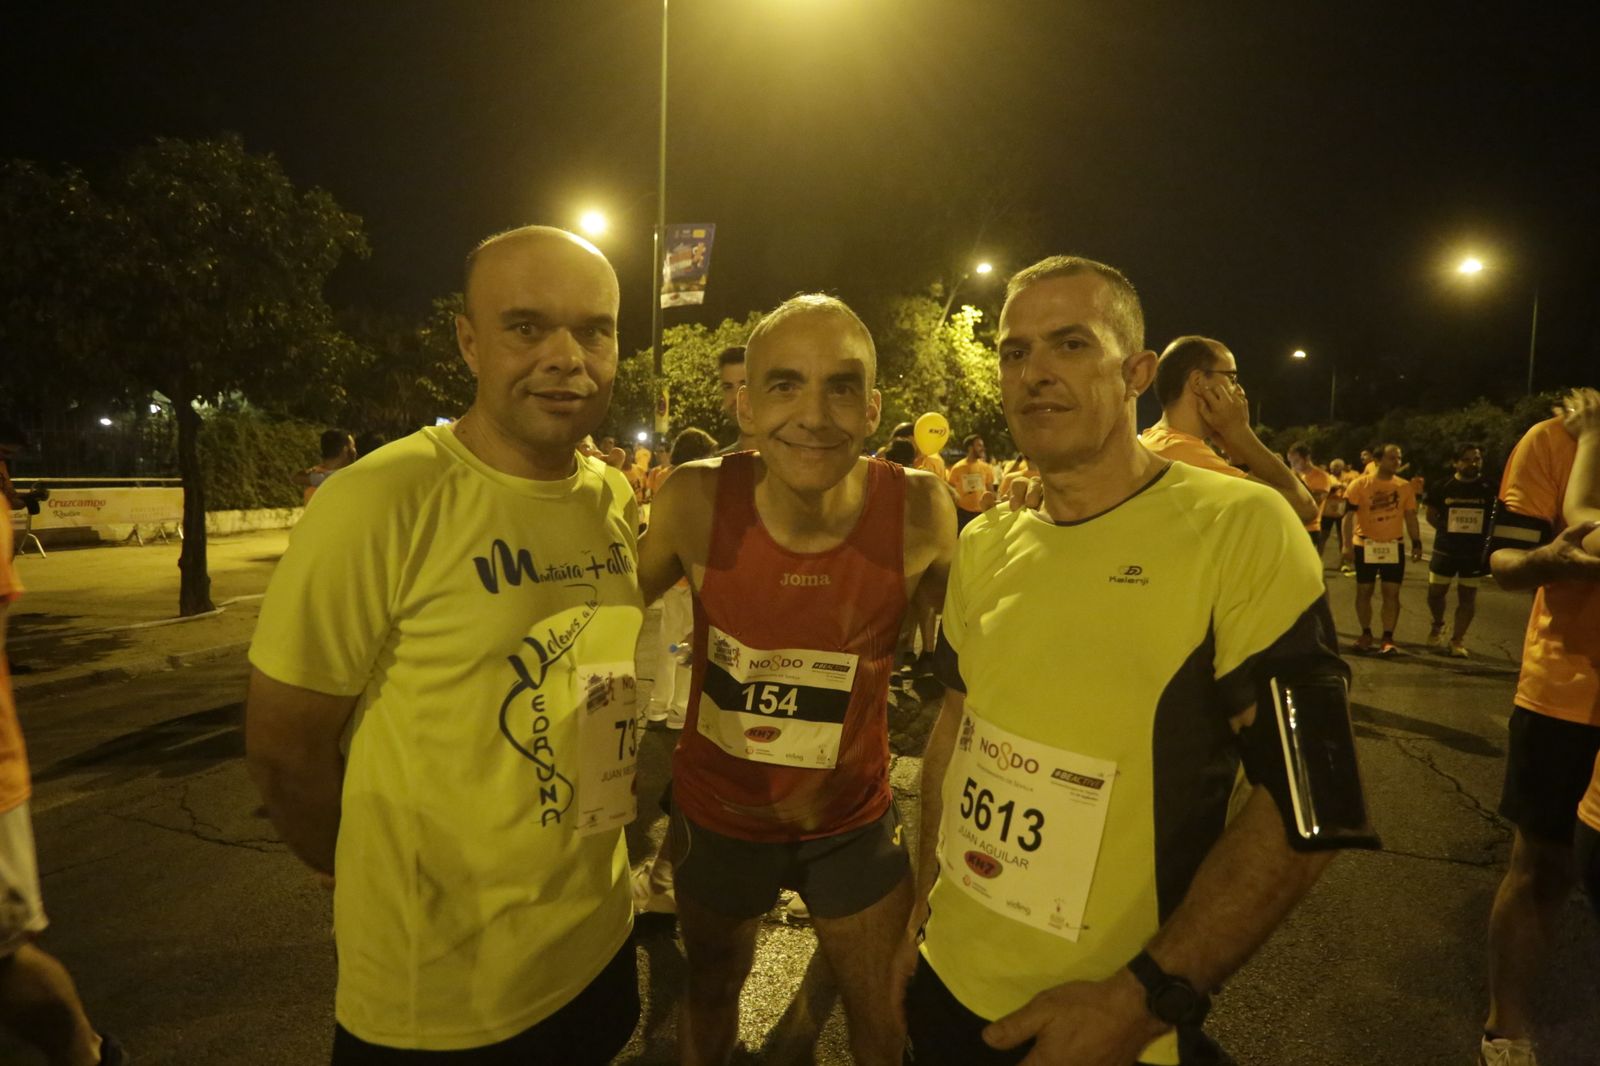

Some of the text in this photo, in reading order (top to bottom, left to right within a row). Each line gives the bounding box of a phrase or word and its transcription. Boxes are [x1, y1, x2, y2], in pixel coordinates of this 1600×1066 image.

[48, 499, 106, 510] Cruzcampo
[741, 683, 798, 716] 154
[960, 776, 1045, 852] 5613
[978, 839, 1030, 870] AGUILAR
